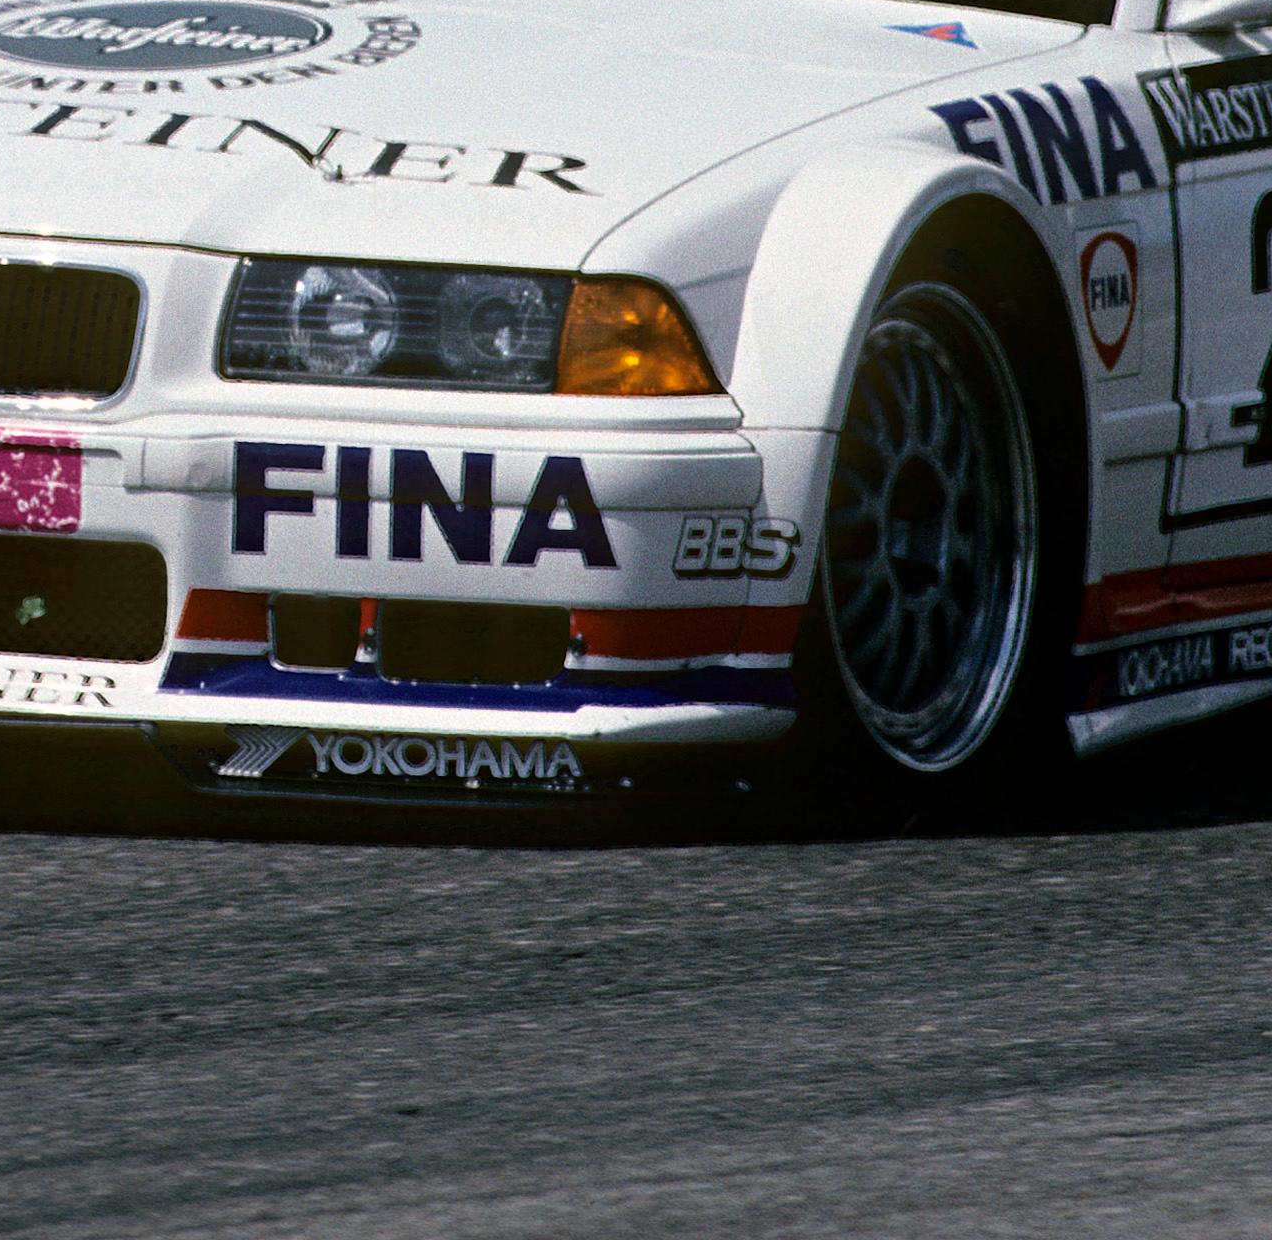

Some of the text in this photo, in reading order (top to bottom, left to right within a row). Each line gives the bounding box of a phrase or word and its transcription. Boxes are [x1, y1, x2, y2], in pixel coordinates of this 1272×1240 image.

[208, 62, 339, 91] DEN
[928, 75, 1158, 206] FINA
[1090, 273, 1130, 312] FINA
[232, 440, 619, 570] FINA
[672, 512, 802, 580] BBS
[305, 732, 584, 779] YOKOHAMA
